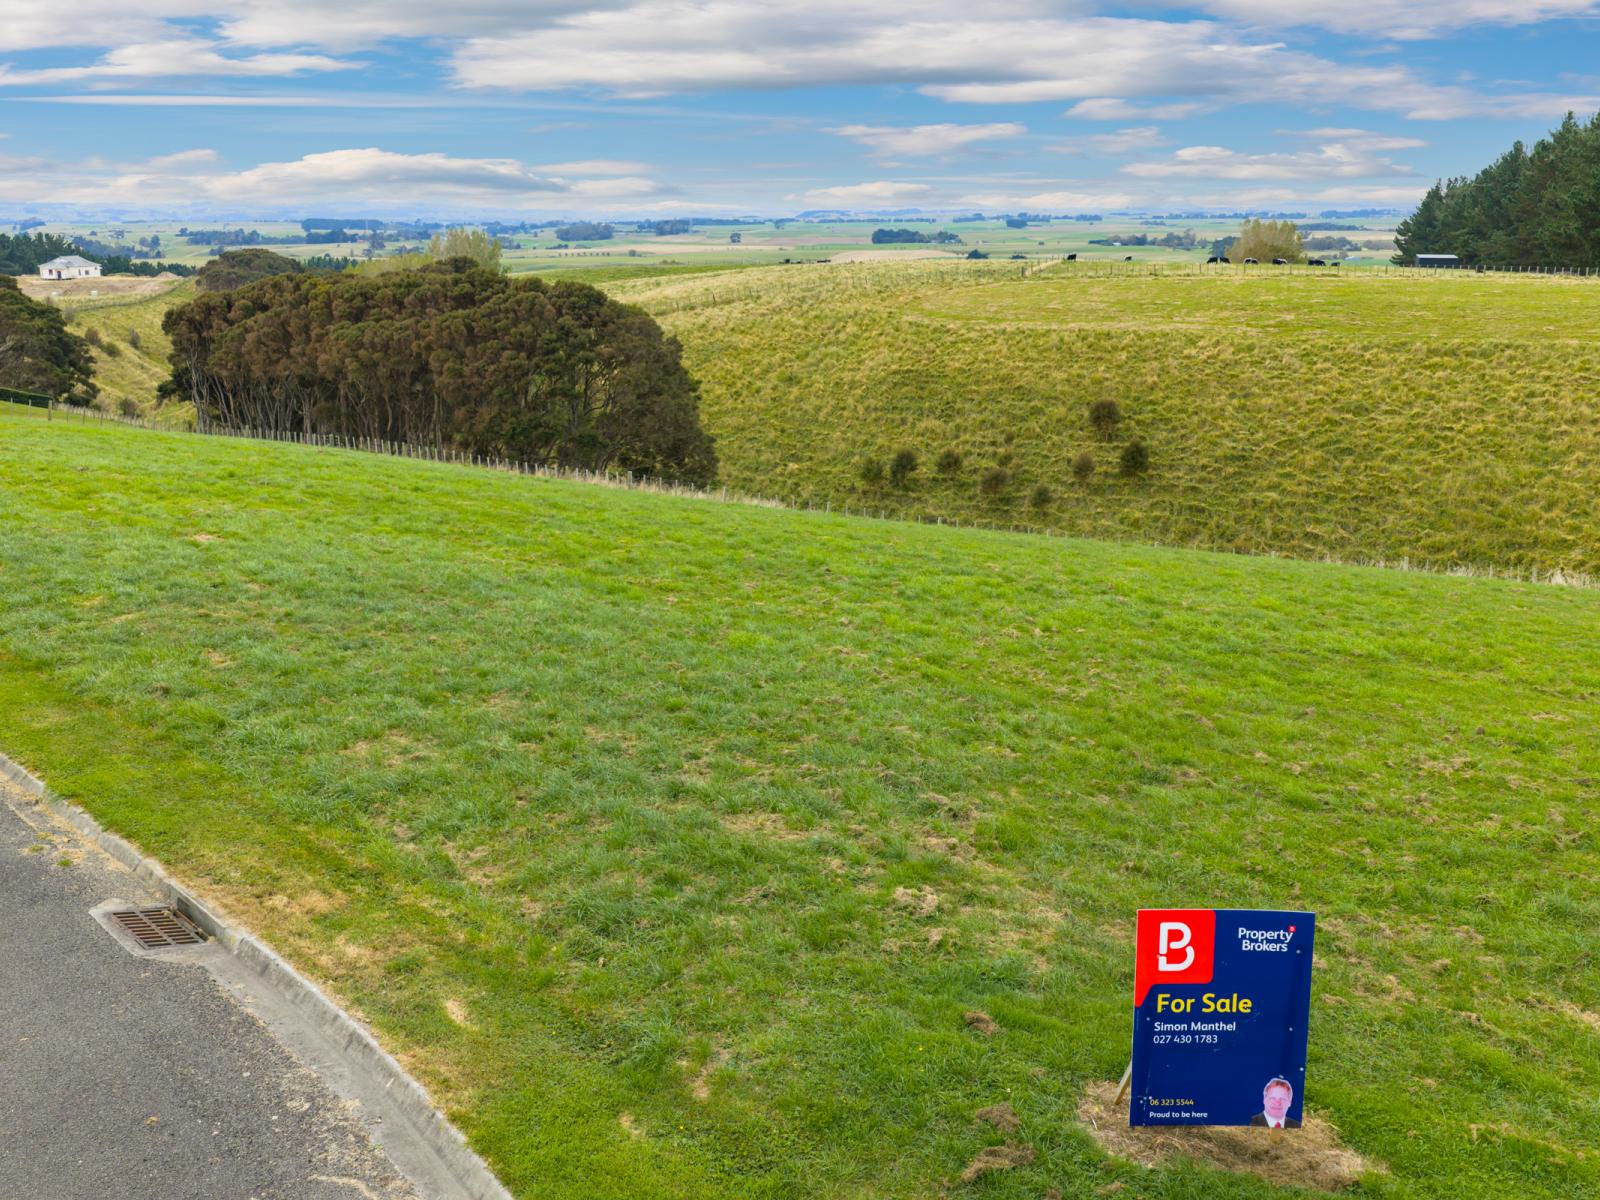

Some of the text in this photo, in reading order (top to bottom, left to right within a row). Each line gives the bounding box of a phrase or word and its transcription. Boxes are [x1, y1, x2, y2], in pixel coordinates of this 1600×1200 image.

[1238, 927, 1293, 943] Property
[1242, 939, 1288, 952] Brokers
[1157, 993, 1252, 1013] For Sale
[1154, 1021, 1236, 1031] Simon Manthel
[1153, 1034, 1218, 1044] 027 430 1783
